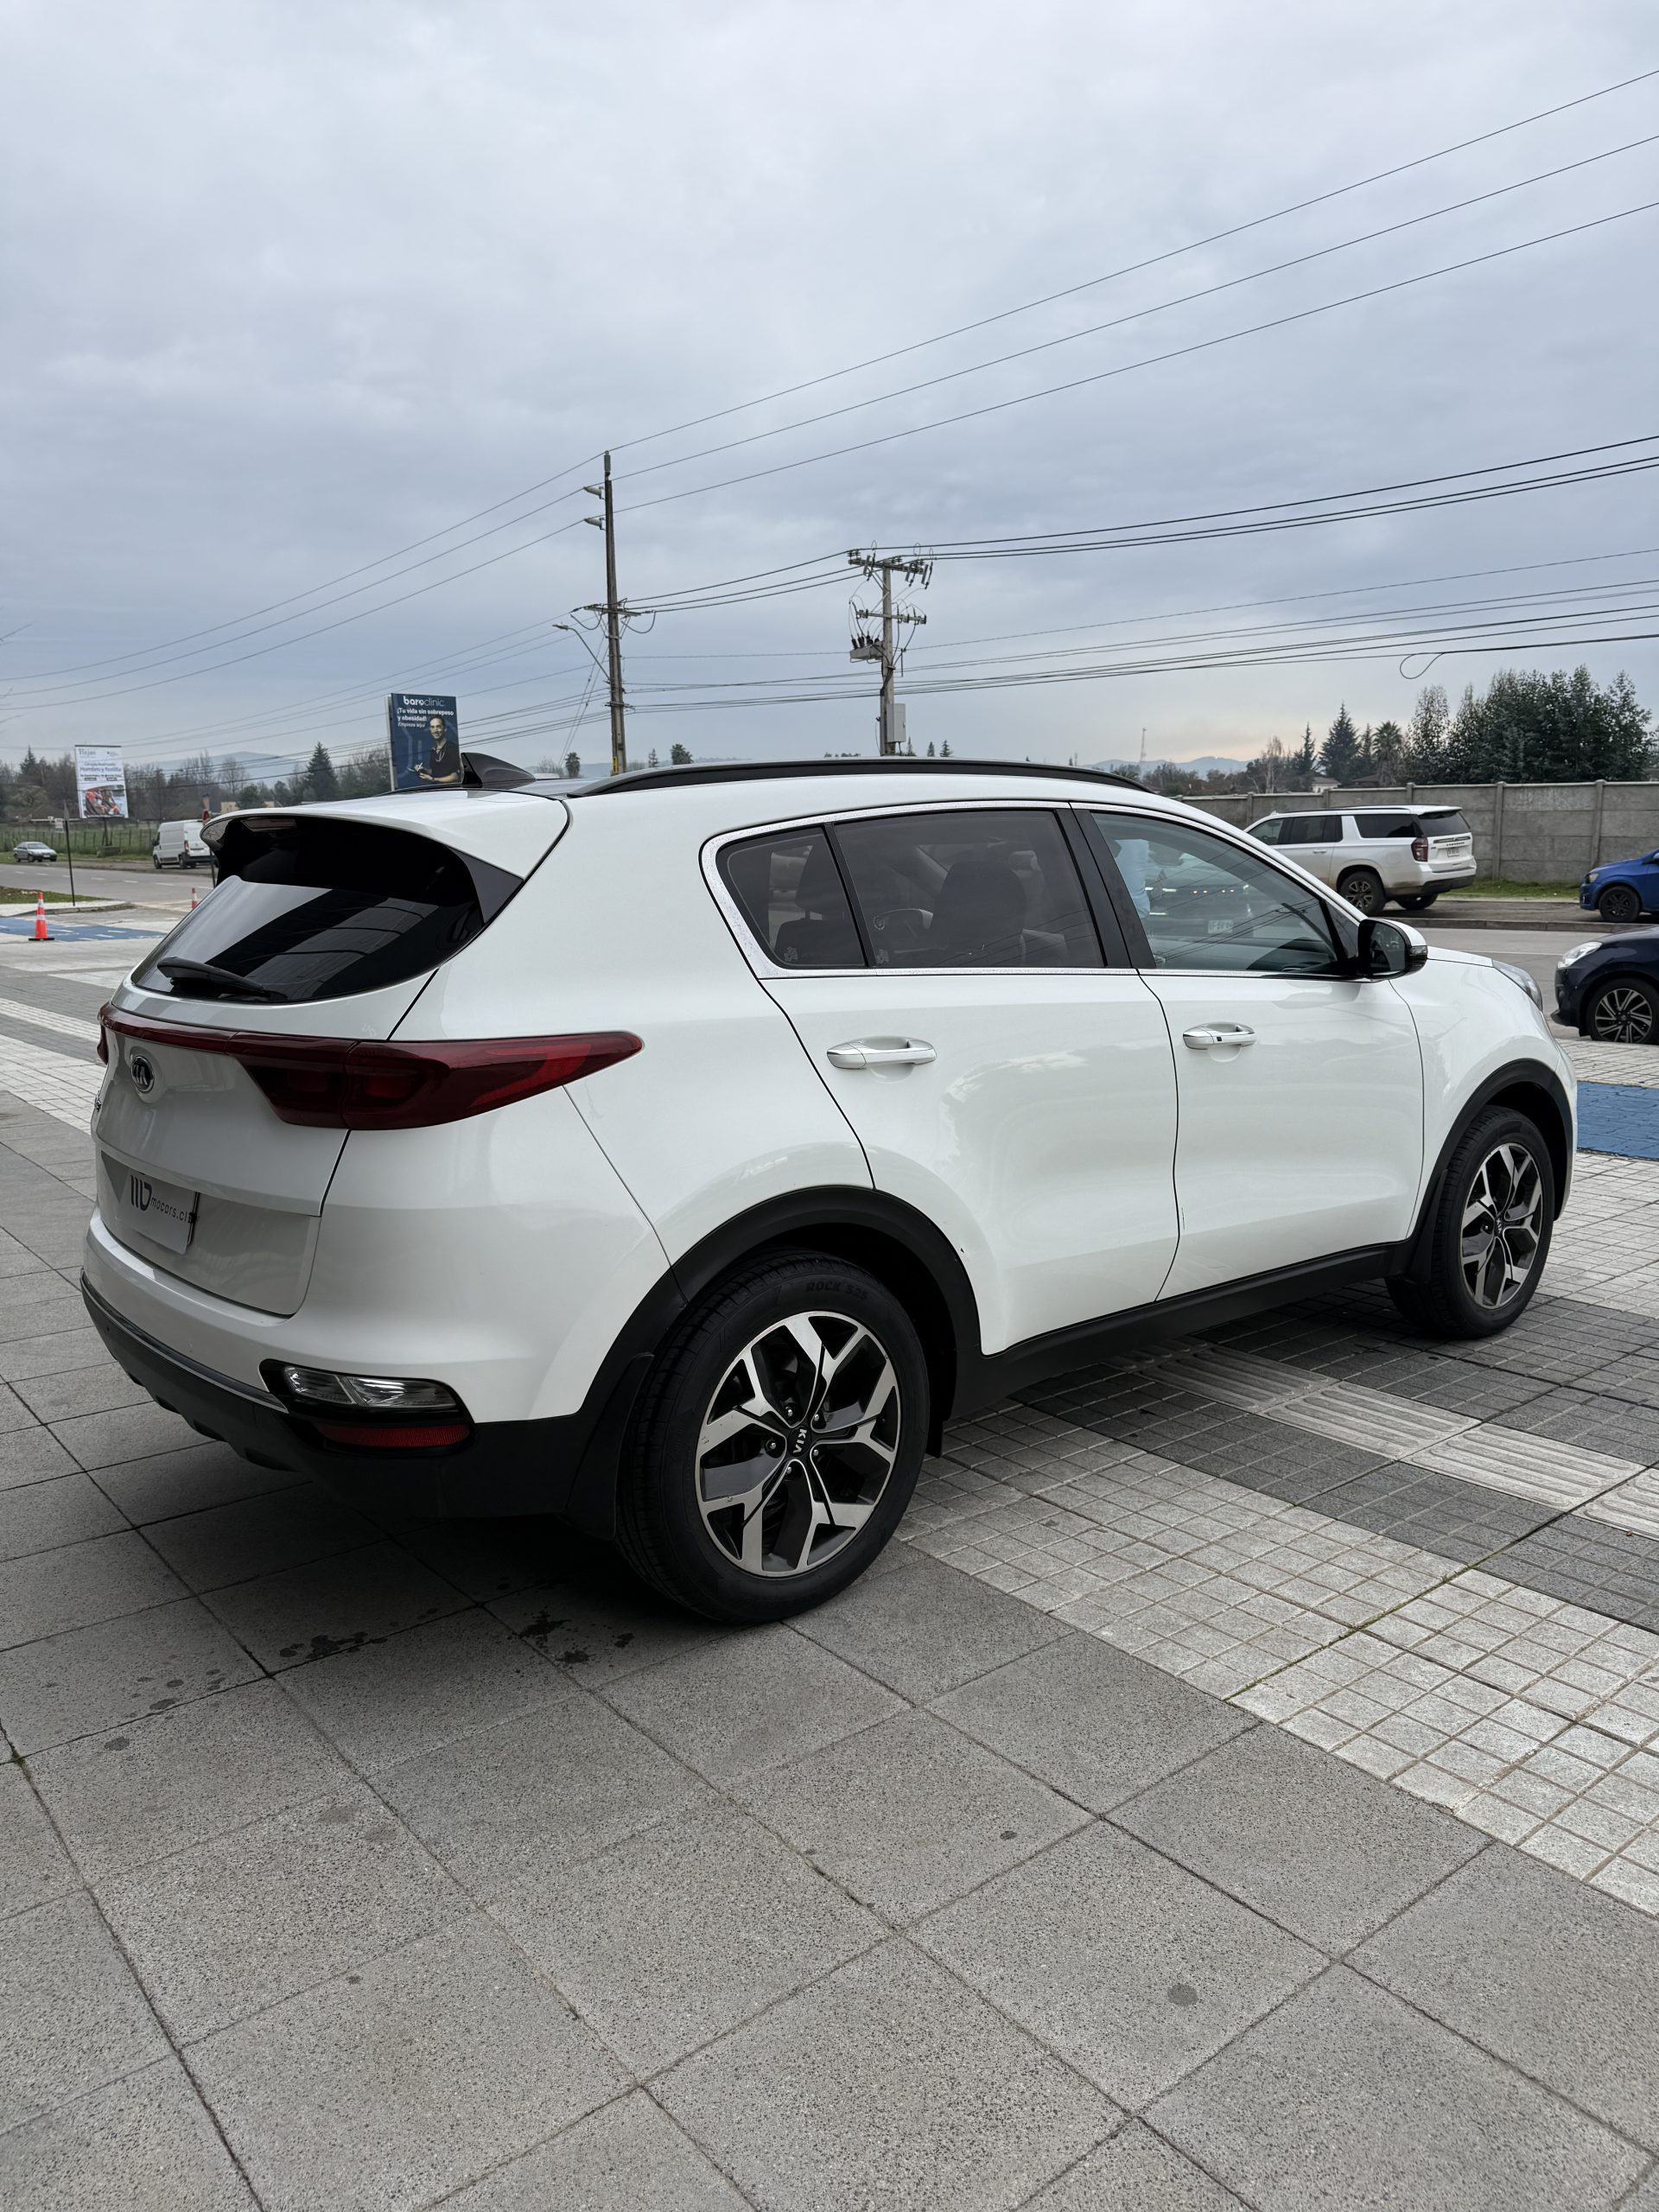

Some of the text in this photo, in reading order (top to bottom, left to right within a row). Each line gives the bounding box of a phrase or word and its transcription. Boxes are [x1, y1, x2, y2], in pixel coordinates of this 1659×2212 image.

[403, 696, 445, 706] baroclinic
[805, 1281, 842, 1293] ROCK
[791, 1428, 808, 1453] KIA
